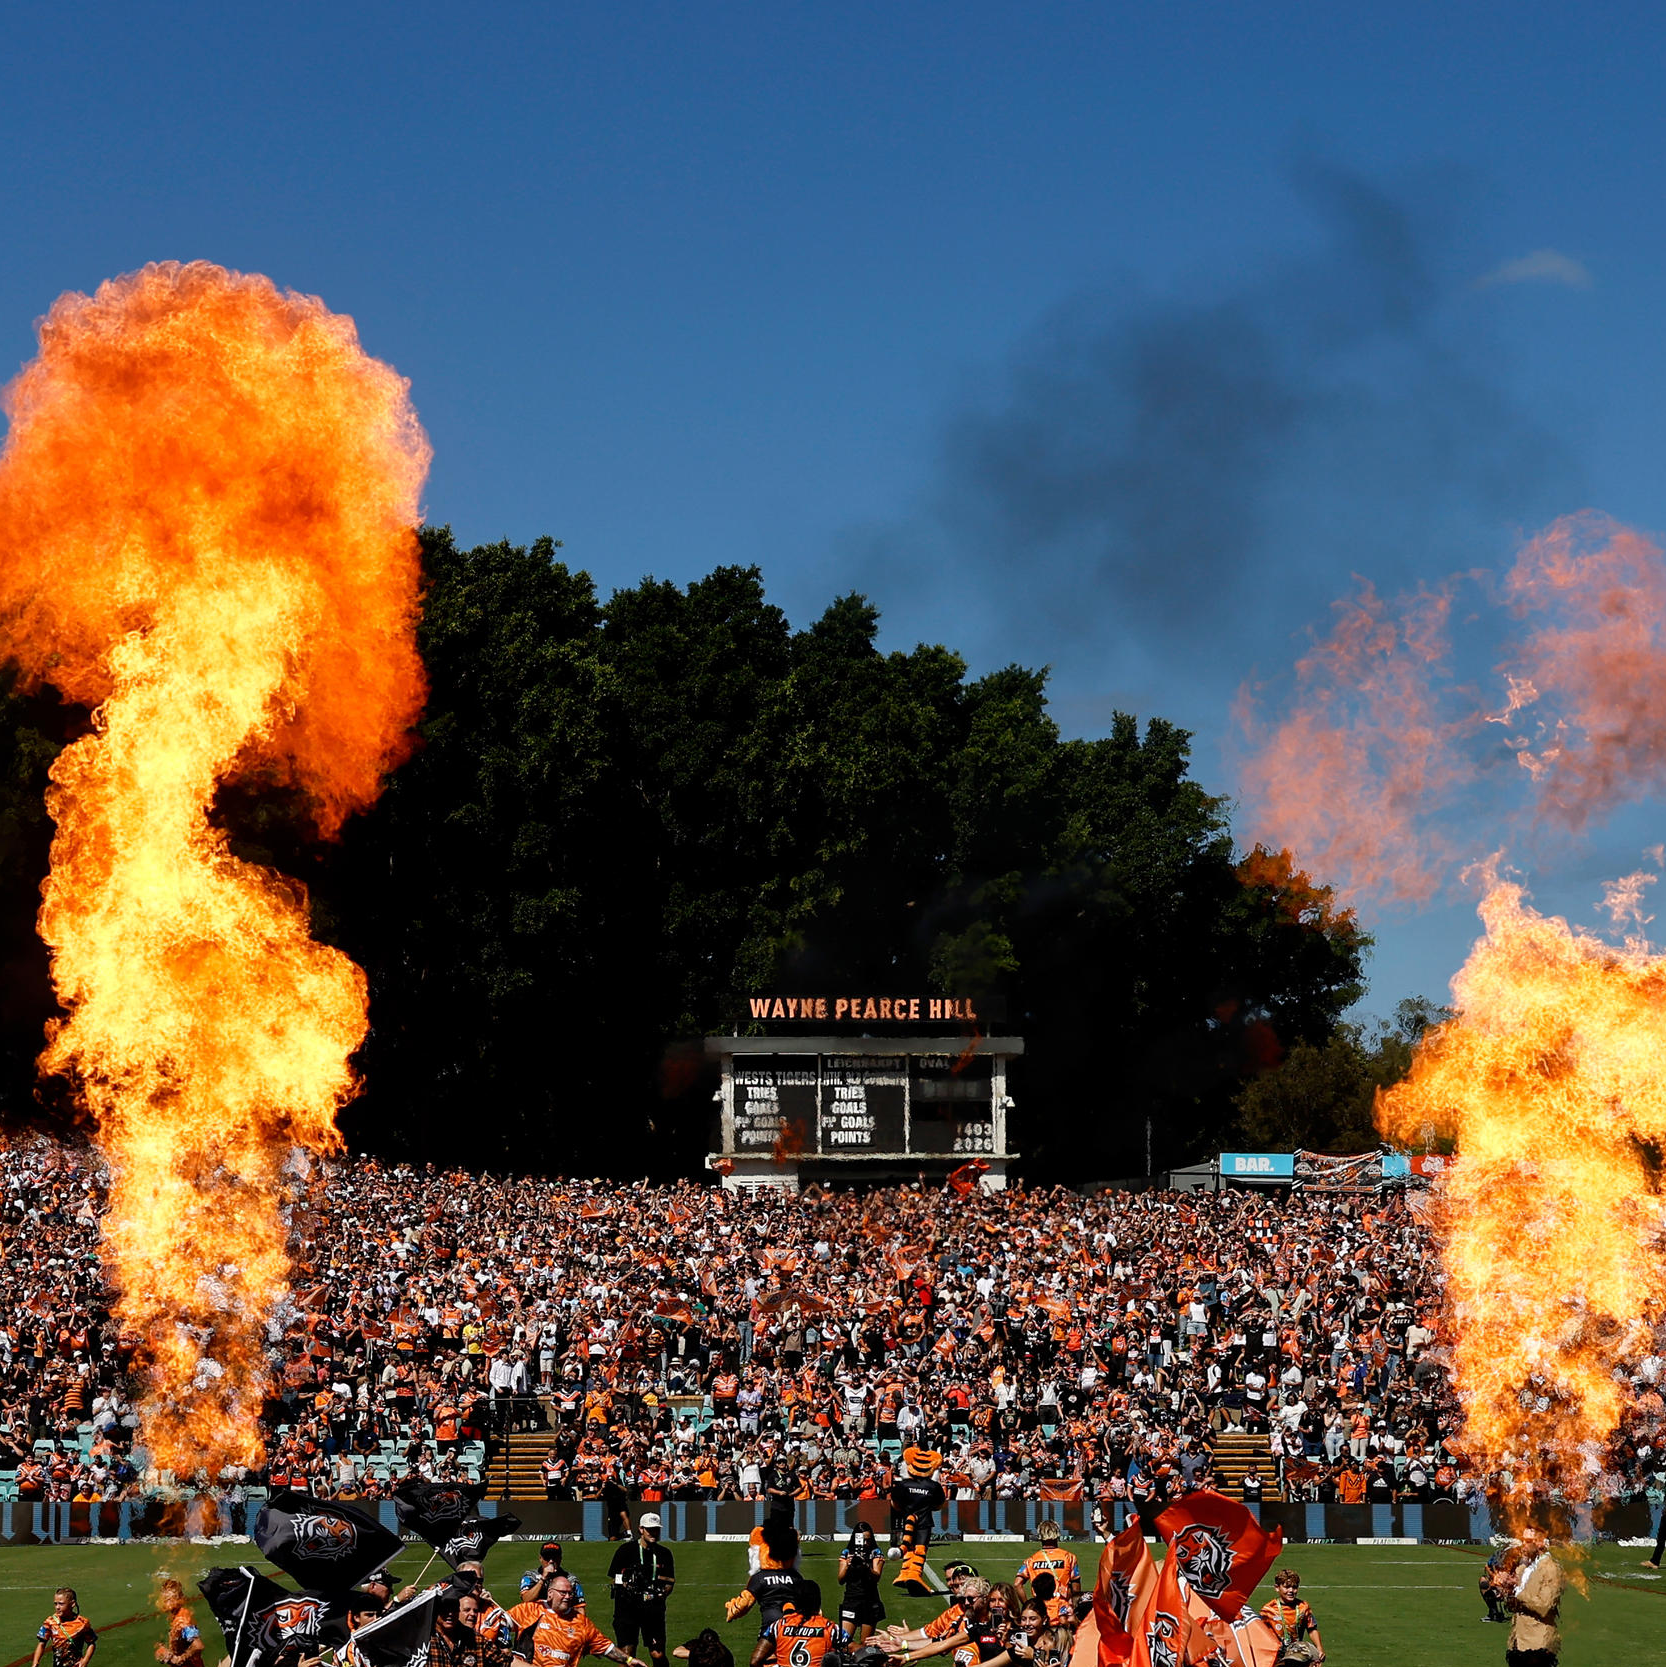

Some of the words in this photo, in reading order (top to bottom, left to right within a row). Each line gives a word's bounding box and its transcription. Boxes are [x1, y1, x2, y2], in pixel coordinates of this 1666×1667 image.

[750, 998, 829, 1019] WAYNE
[835, 998, 920, 1020] PEARCE
[929, 998, 978, 1020] HILL
[734, 1071, 774, 1086] WESTS
[777, 1071, 817, 1087] TIGERS
[746, 1086, 779, 1099] TRIES
[834, 1086, 867, 1100] TRIES
[832, 1101, 868, 1115] GOALS
[841, 1115, 876, 1129] GOALS
[830, 1130, 872, 1145] POINTS
[1235, 1157, 1274, 1173] BAR.
[907, 1487, 930, 1497] TIMMY
[764, 1575, 793, 1588] TINA
